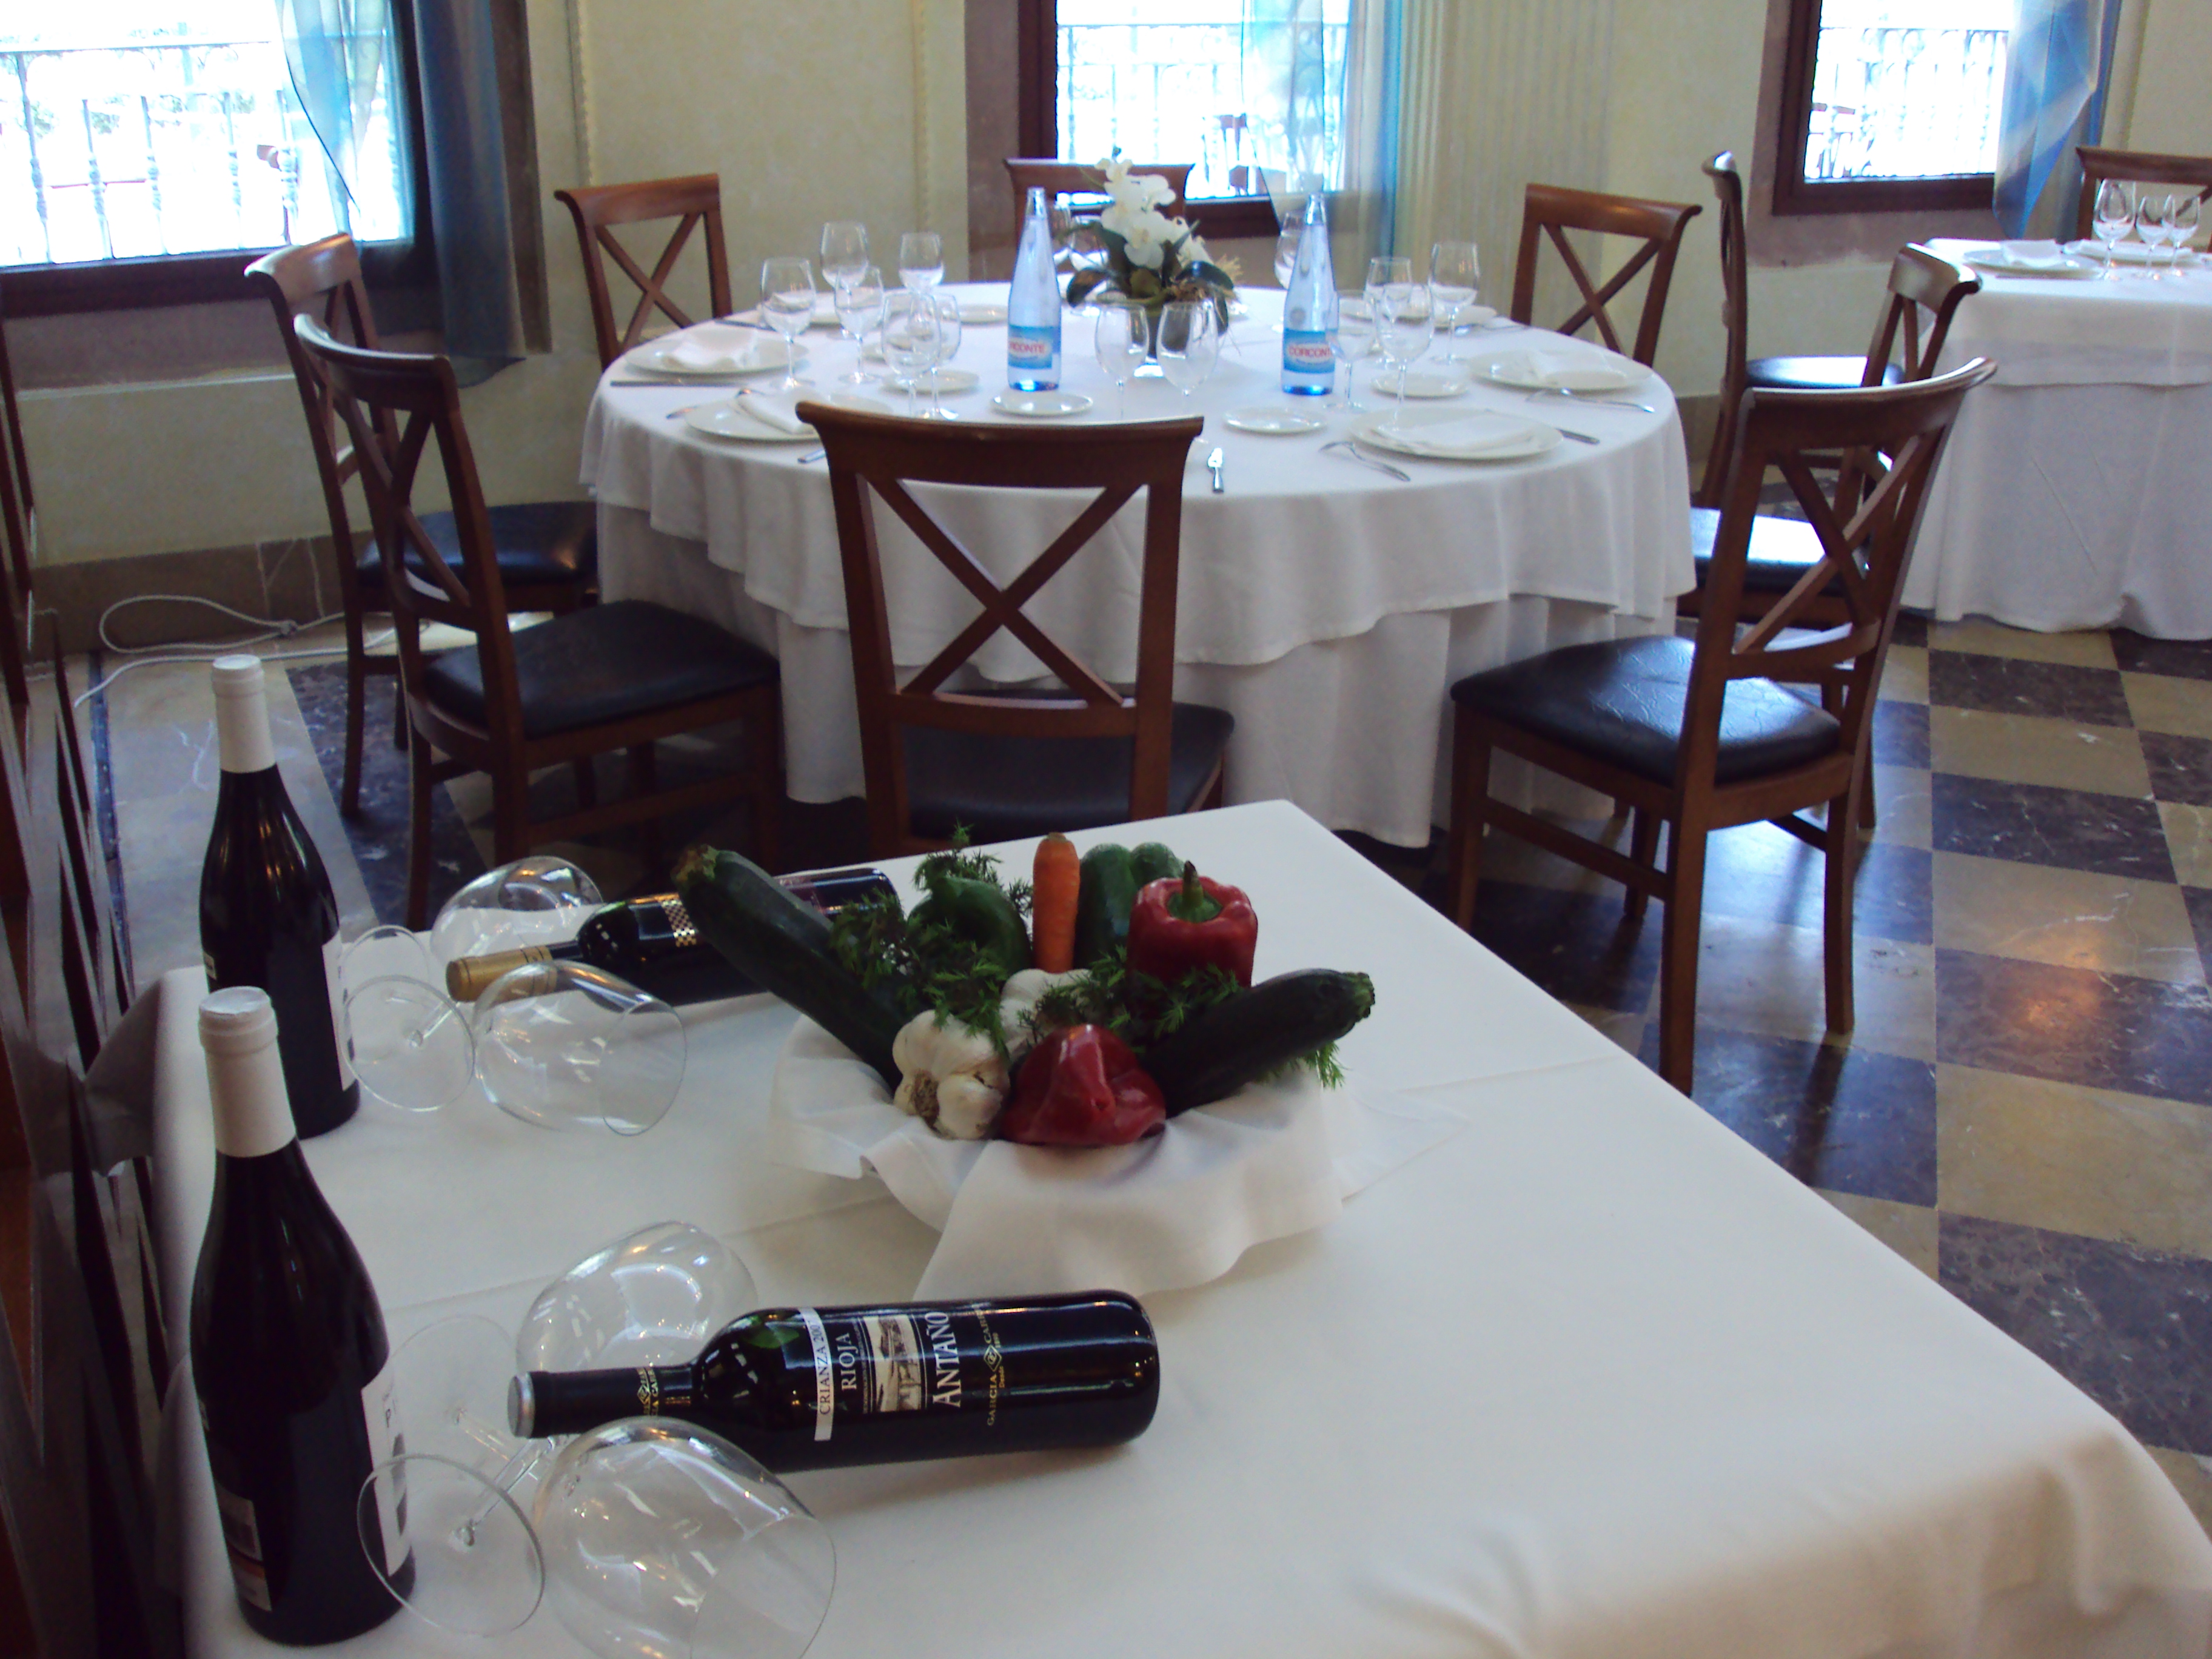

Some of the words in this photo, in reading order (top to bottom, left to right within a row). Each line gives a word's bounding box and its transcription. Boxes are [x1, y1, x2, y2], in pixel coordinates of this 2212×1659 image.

[816, 1344, 831, 1415] CRIANZA
[835, 1333, 859, 1392] RIOJA
[925, 1312, 962, 1409] ANTAÑO
[987, 1373, 997, 1426] GARCIA
